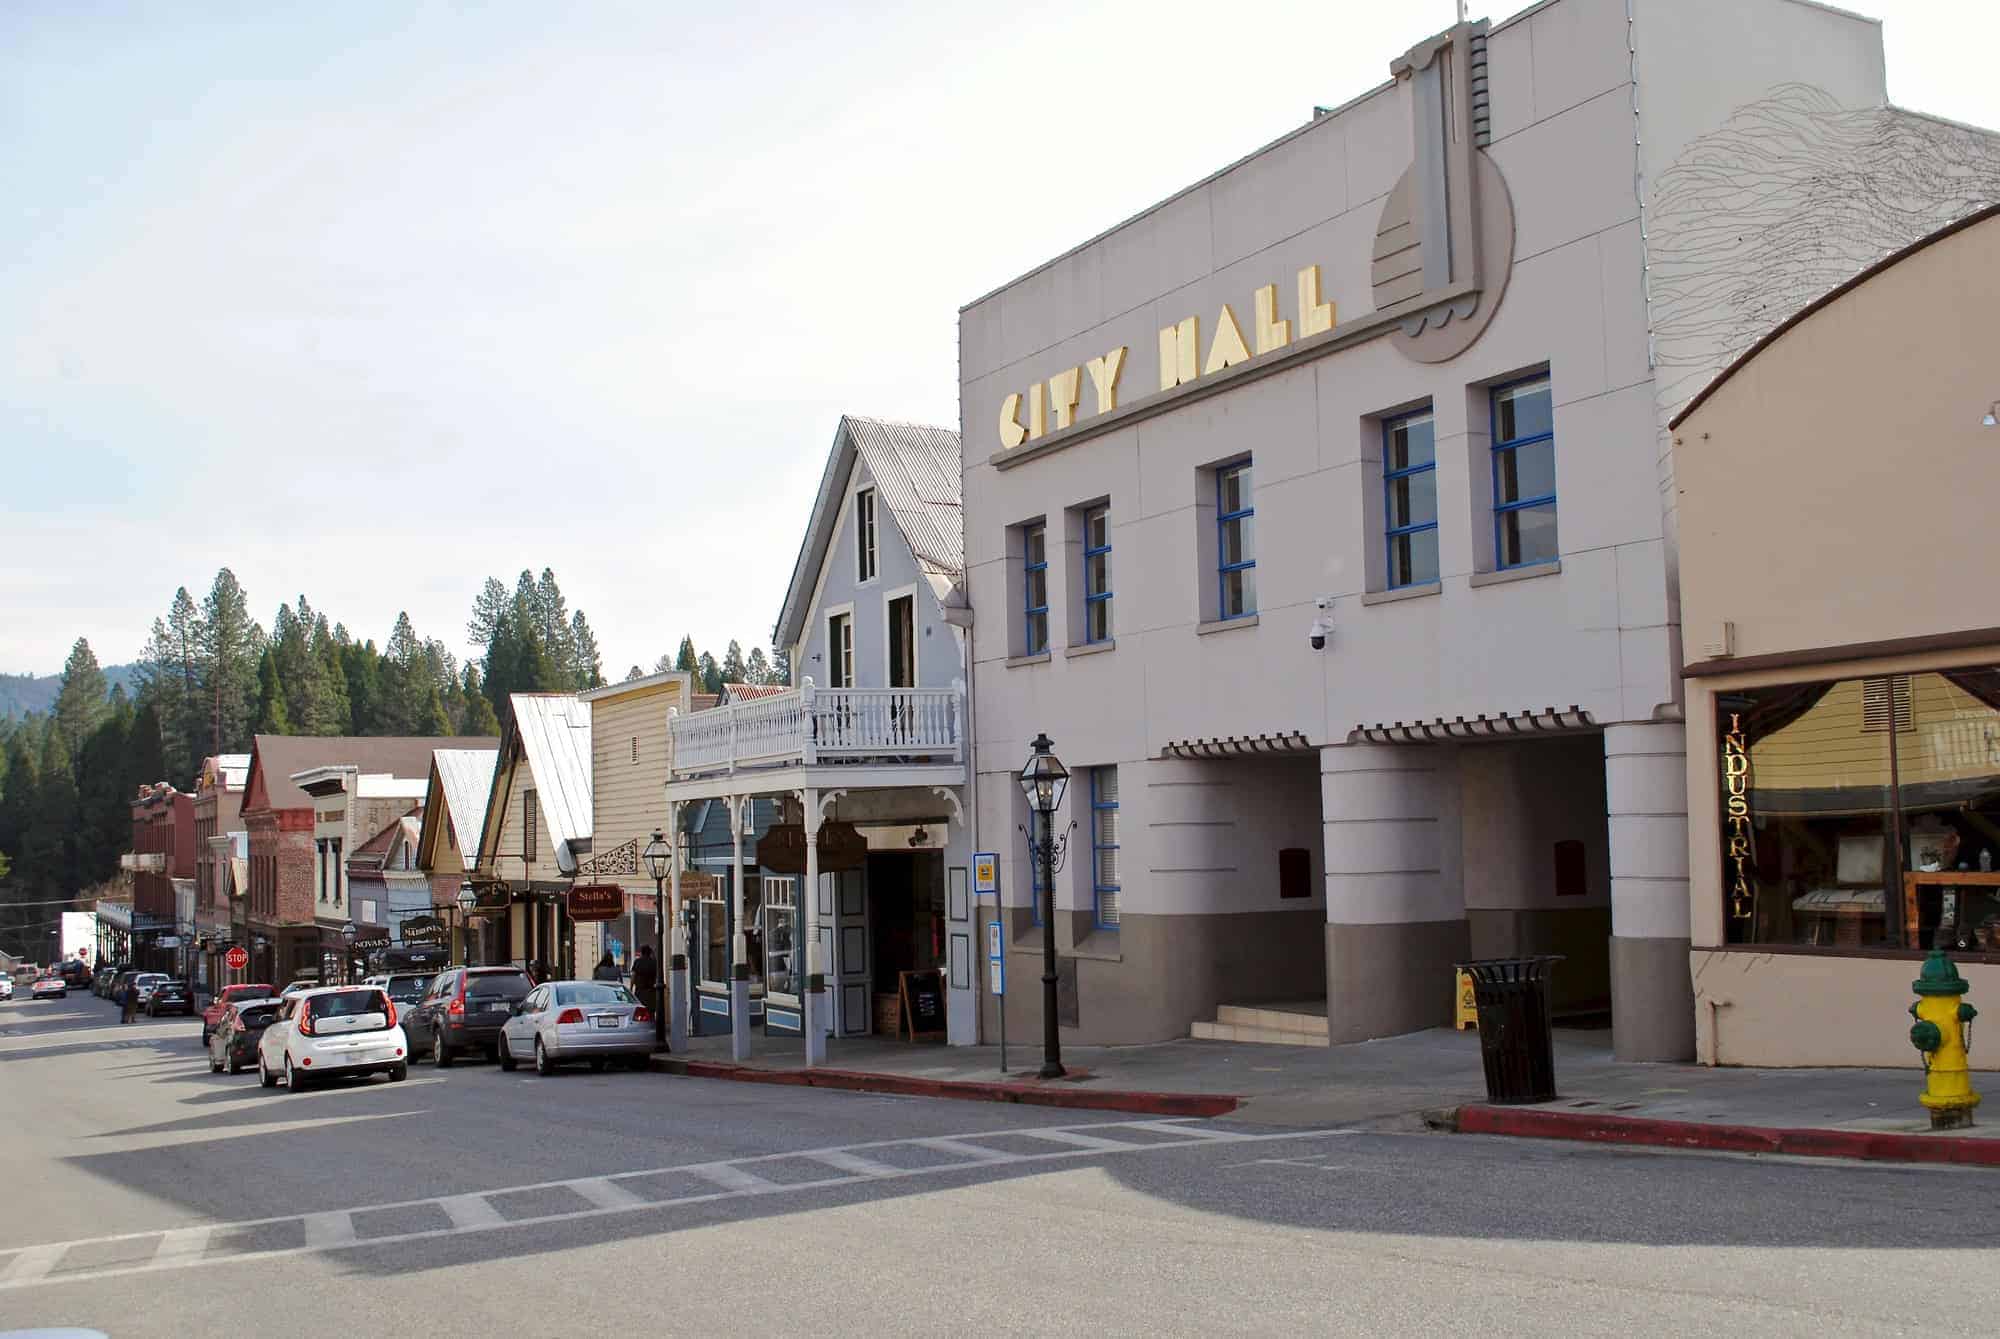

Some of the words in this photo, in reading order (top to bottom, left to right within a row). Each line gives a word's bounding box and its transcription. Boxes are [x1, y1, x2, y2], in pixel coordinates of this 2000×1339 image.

[999, 345, 1128, 449] CITY
[1159, 264, 1336, 392] HALL
[1725, 713, 1752, 919] INDUSTRIAL
[227, 953, 247, 963] STOP
[354, 936, 390, 950] NOVAK'S
